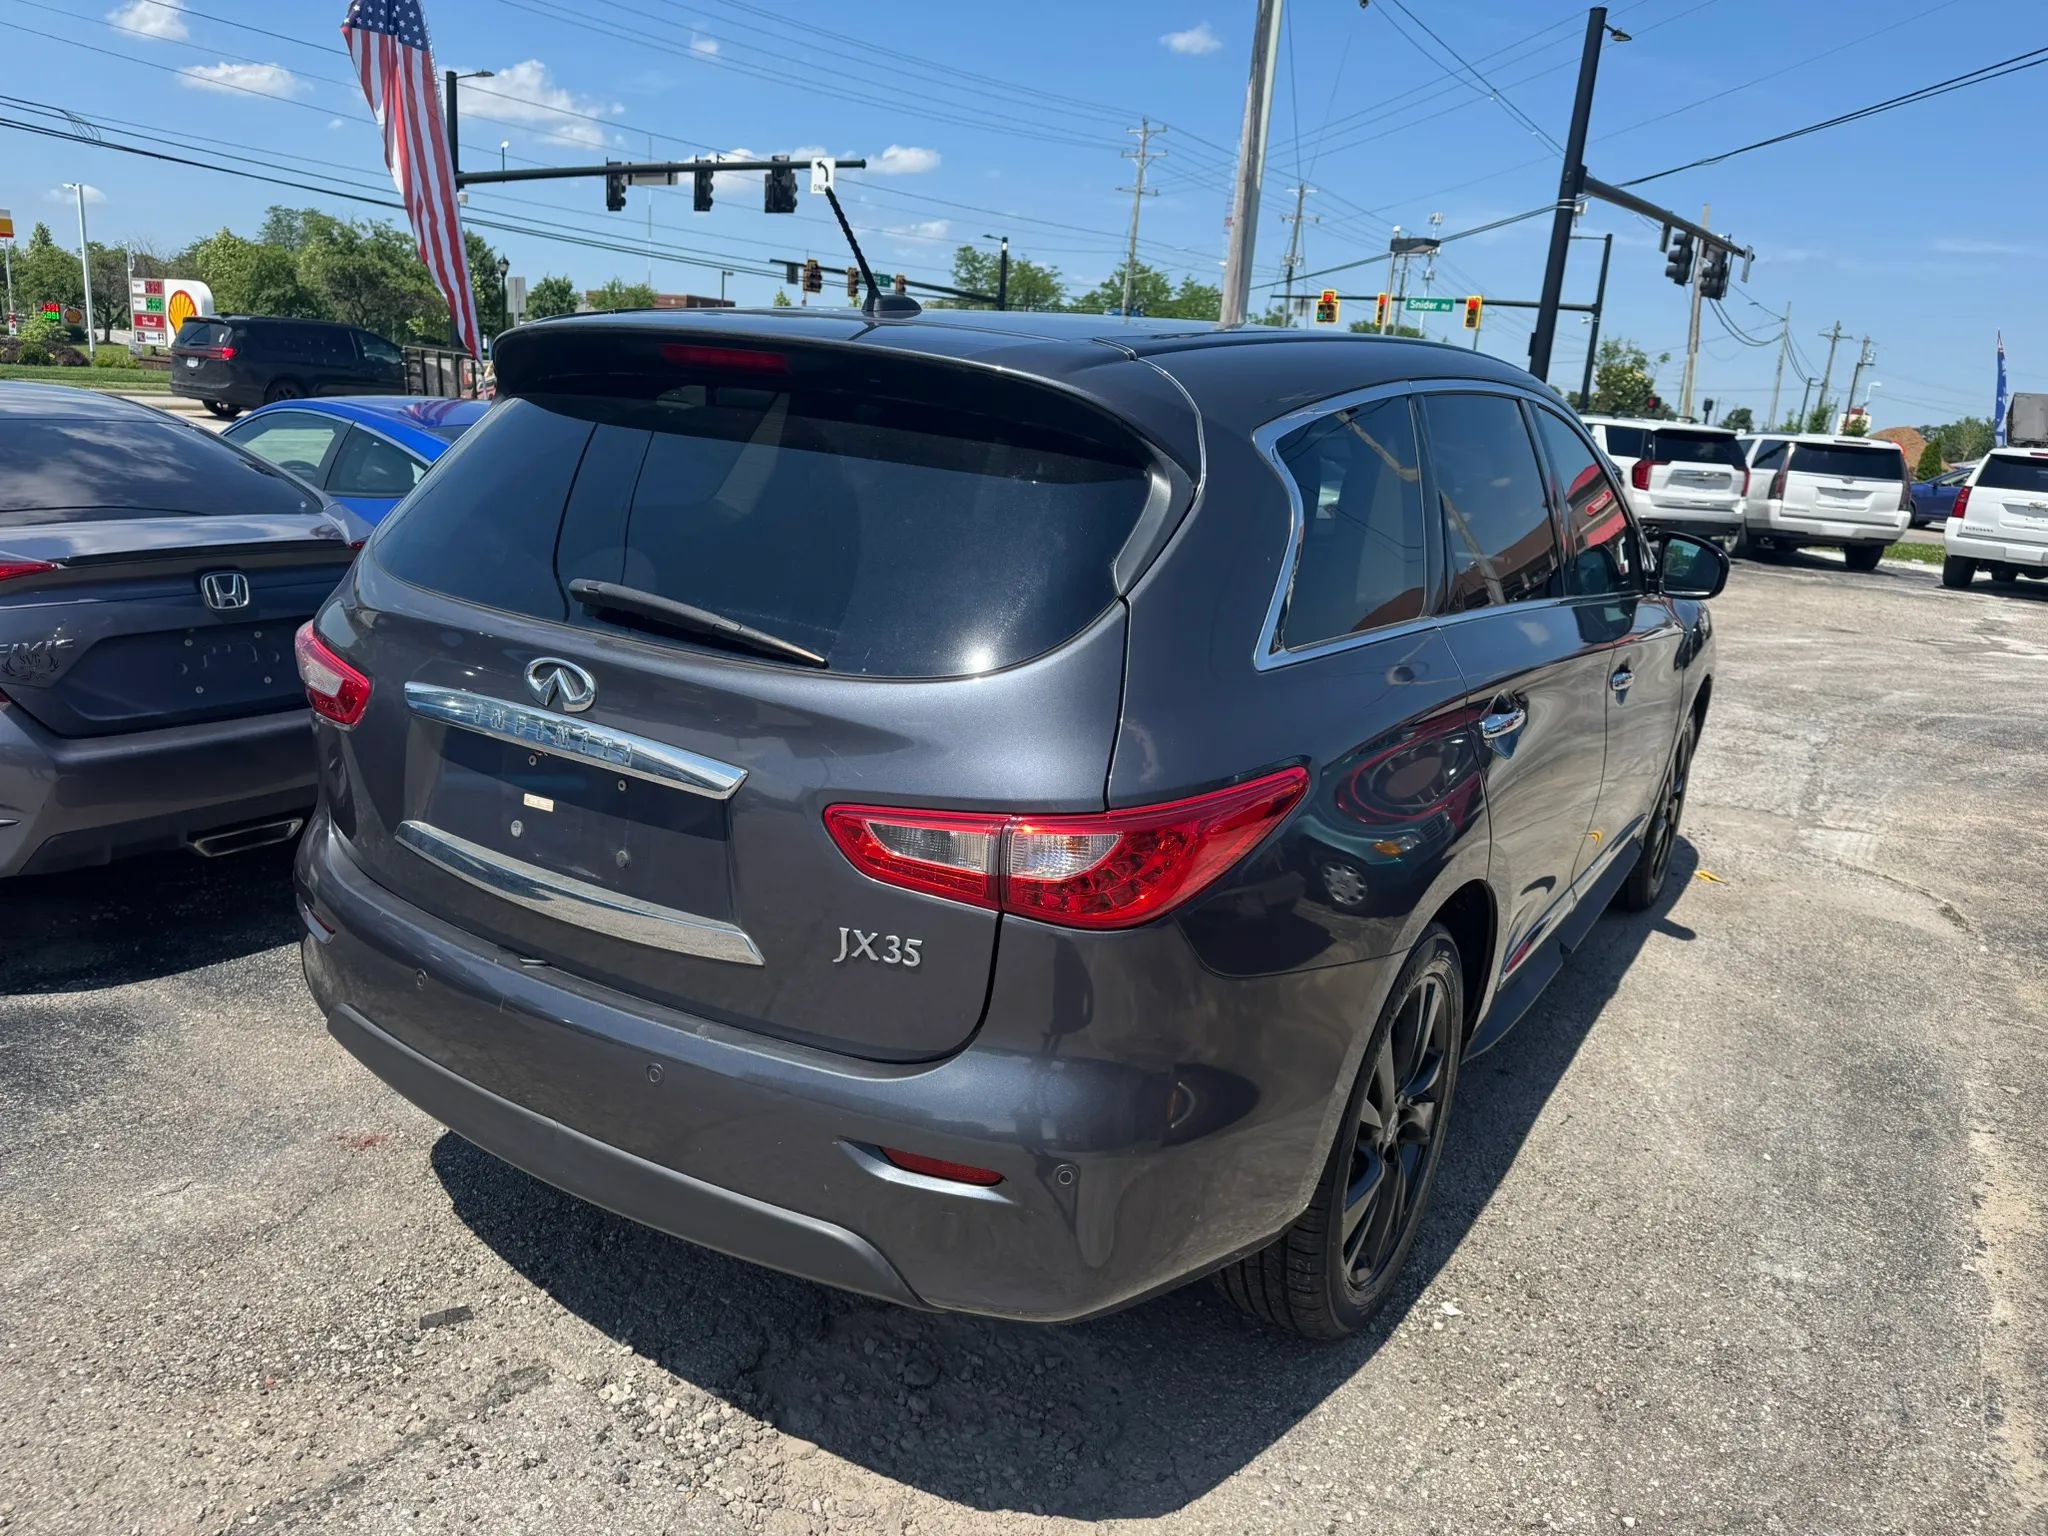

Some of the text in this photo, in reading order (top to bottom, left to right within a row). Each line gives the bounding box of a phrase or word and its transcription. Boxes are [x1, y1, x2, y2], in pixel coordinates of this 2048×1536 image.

[1410, 300, 1438, 310] Snider
[473, 703, 633, 766] INFINITI
[832, 926, 923, 968] JX35
